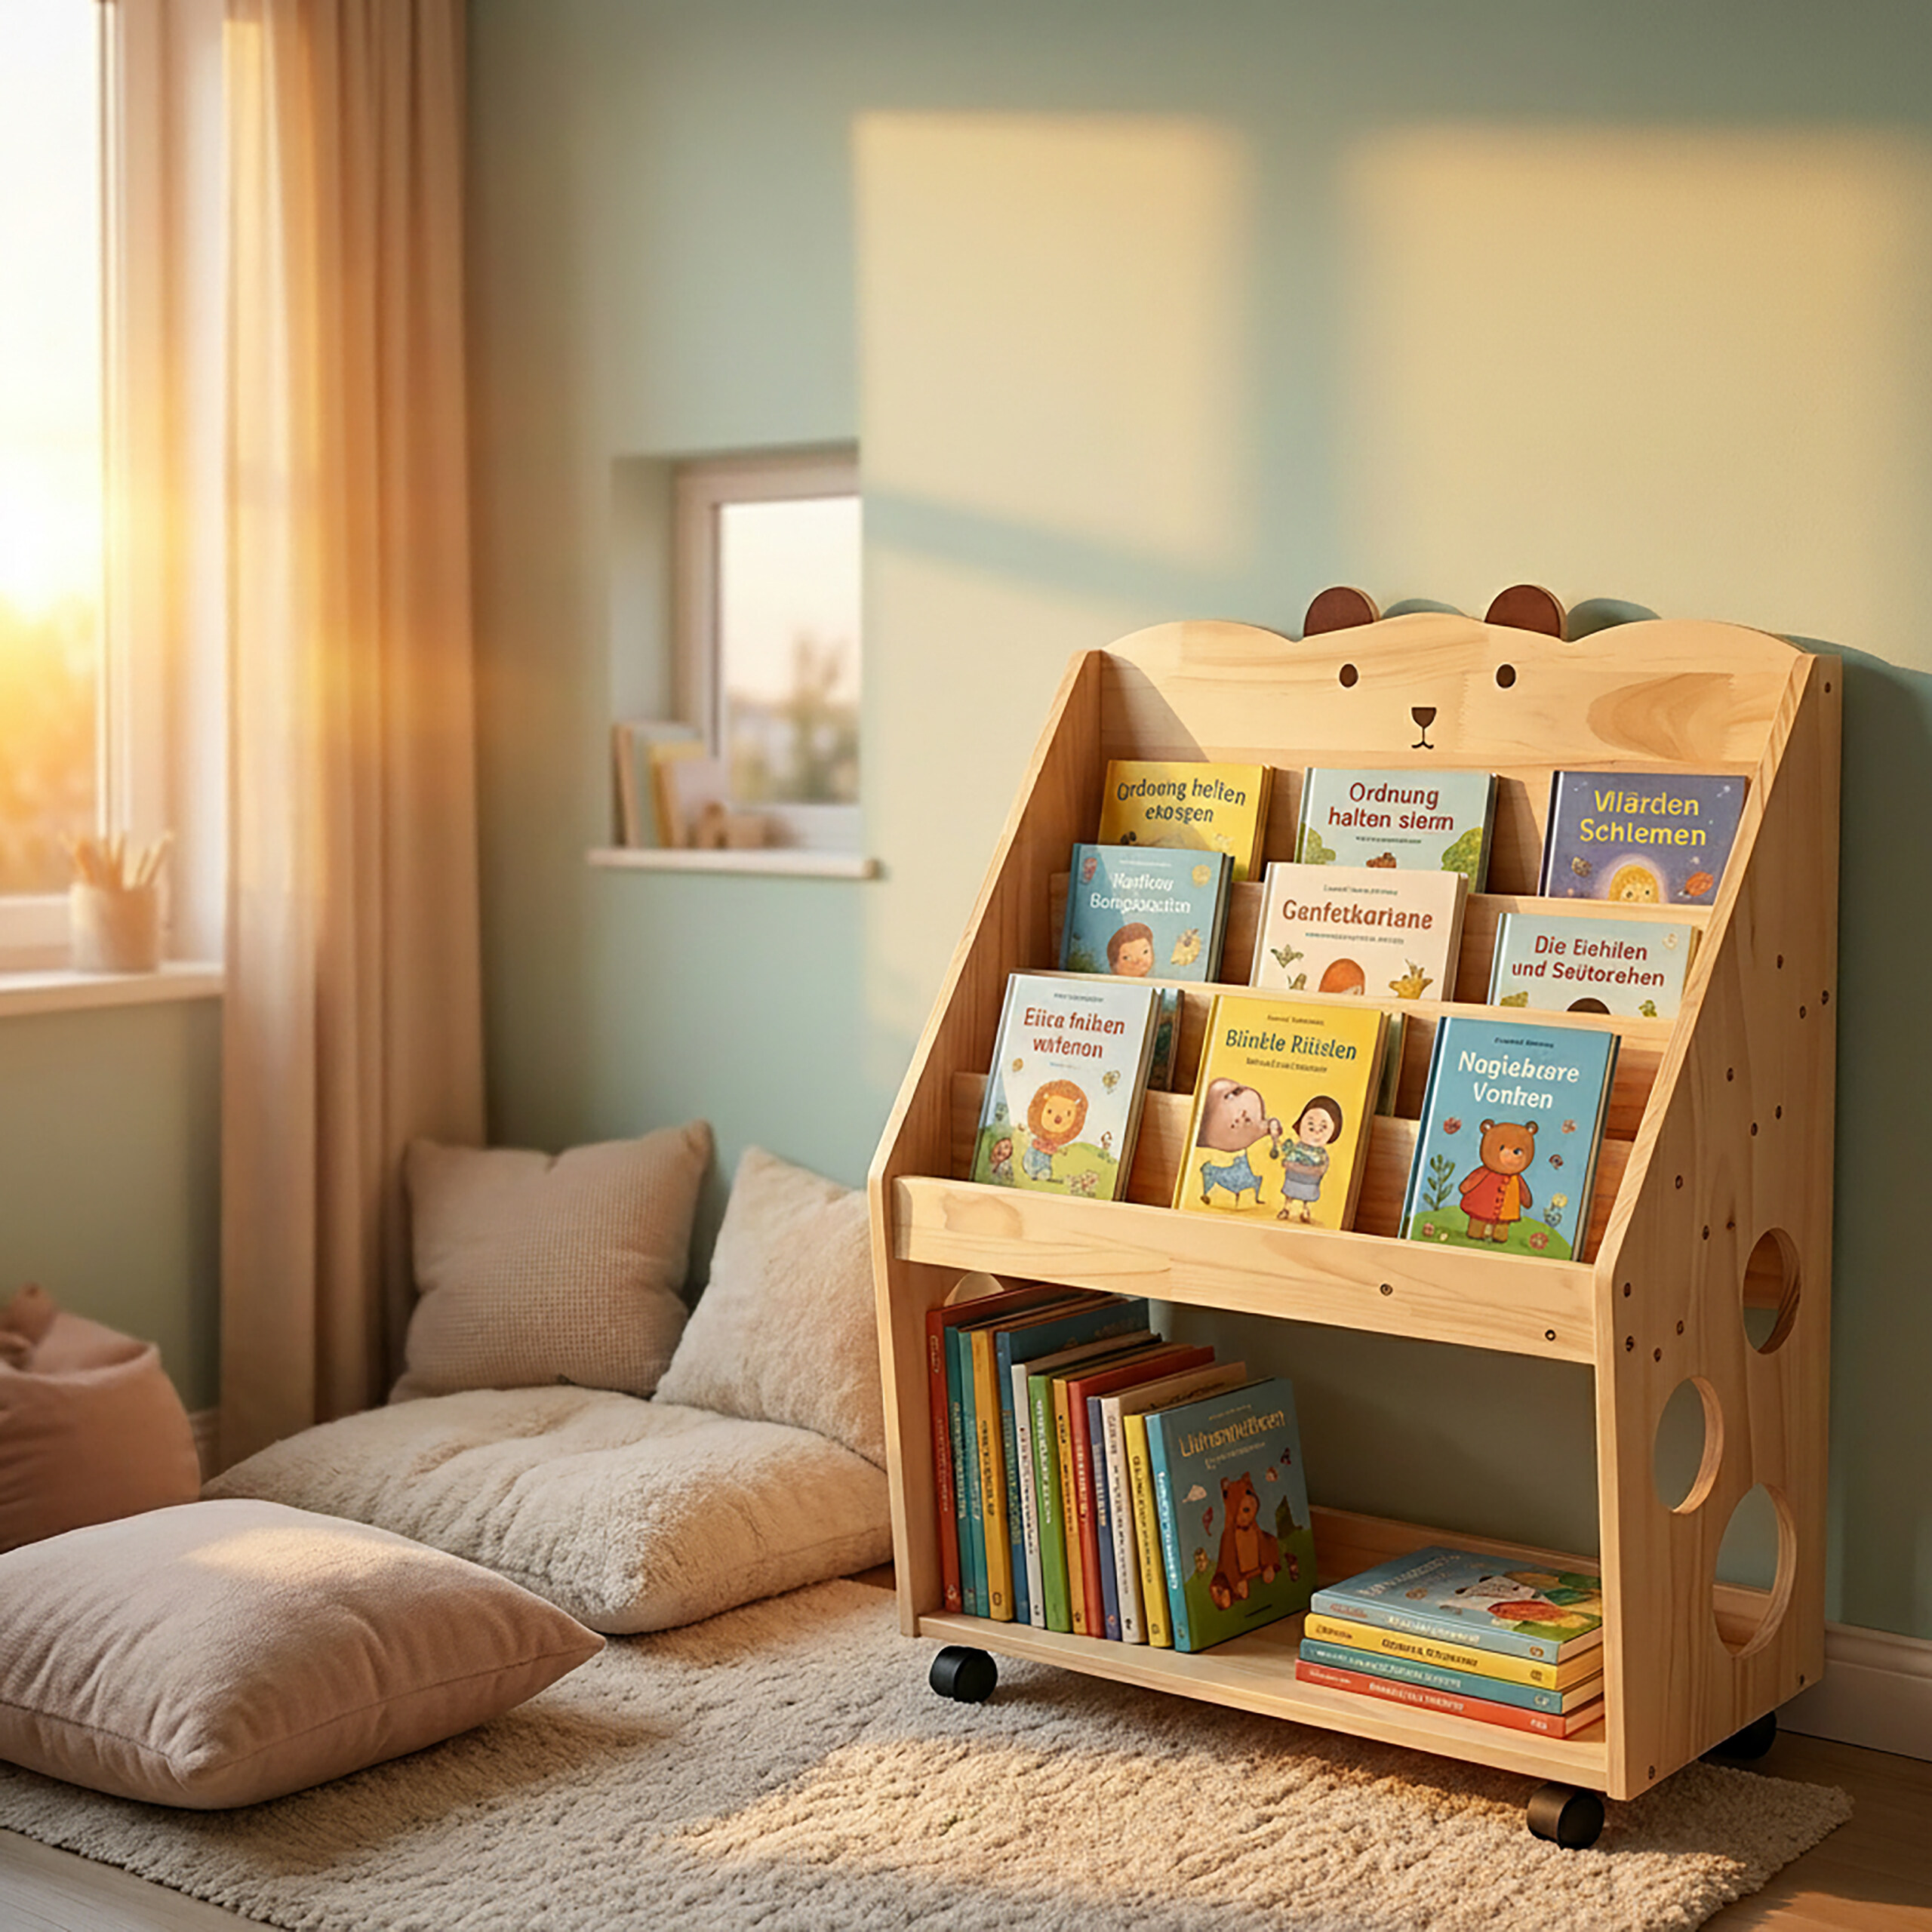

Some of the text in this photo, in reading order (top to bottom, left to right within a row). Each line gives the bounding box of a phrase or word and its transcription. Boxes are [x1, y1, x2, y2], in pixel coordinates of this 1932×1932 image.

[1349, 781, 1439, 811] Ordnung
[1328, 806, 1391, 828] halten
[1580, 818, 1706, 846] Schlemen
[1534, 935, 1567, 955] Die
[1512, 961, 1548, 977] und
